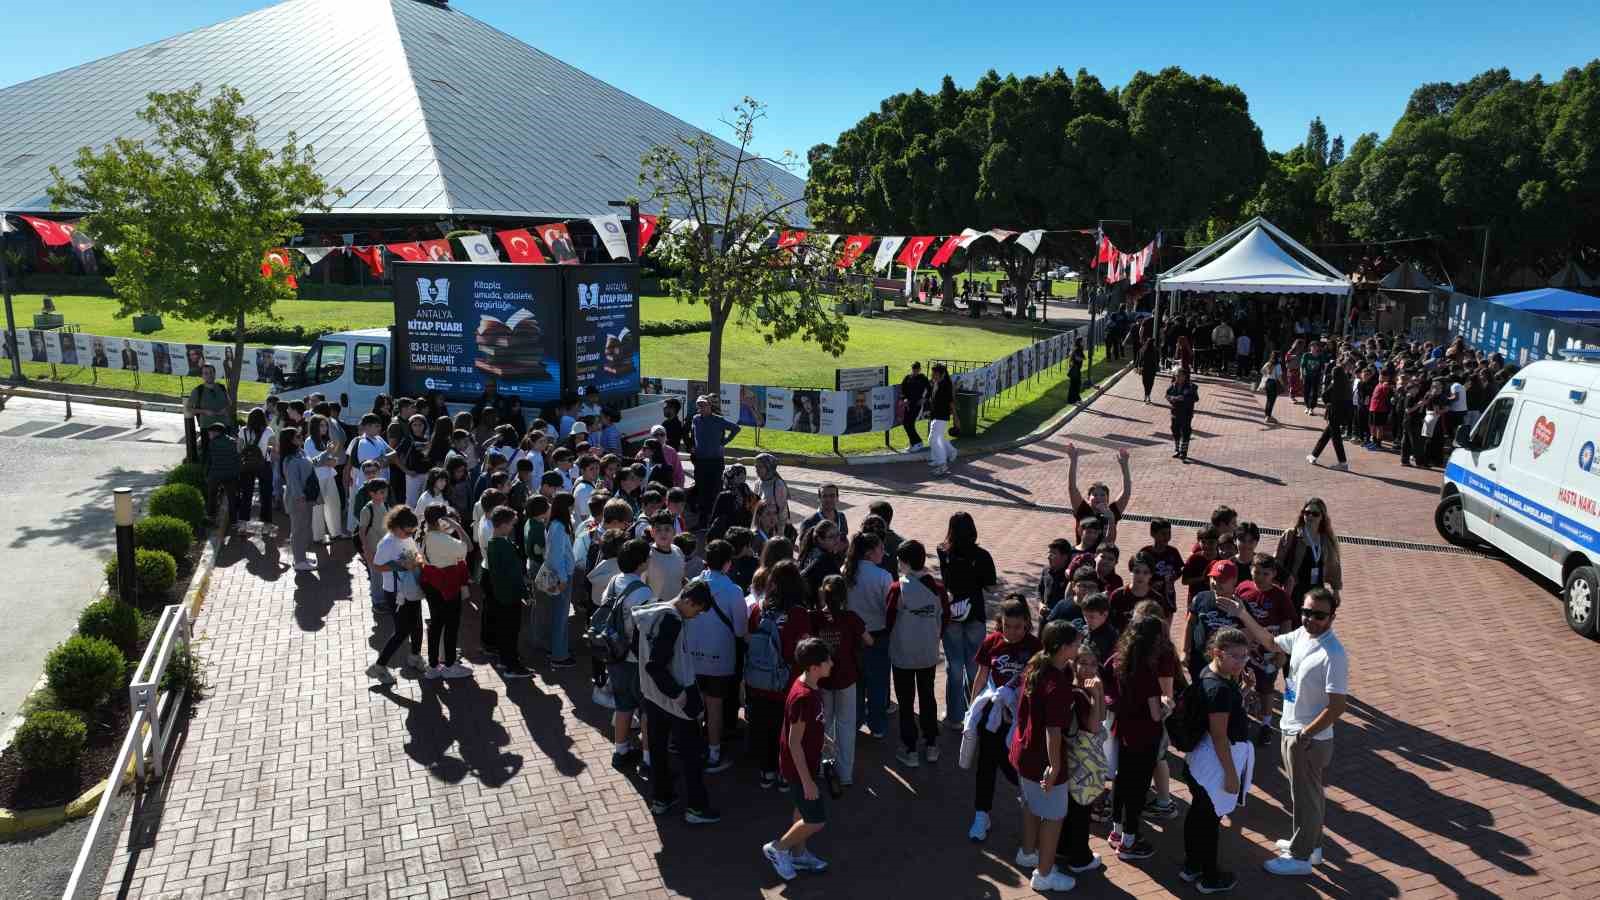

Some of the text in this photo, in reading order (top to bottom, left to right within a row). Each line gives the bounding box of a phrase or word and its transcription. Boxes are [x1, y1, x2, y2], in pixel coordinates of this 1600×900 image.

[416, 310, 453, 319] ANTALYA
[408, 320, 463, 332] KİTAP FUARI
[1558, 488, 1577, 505] HASTA
